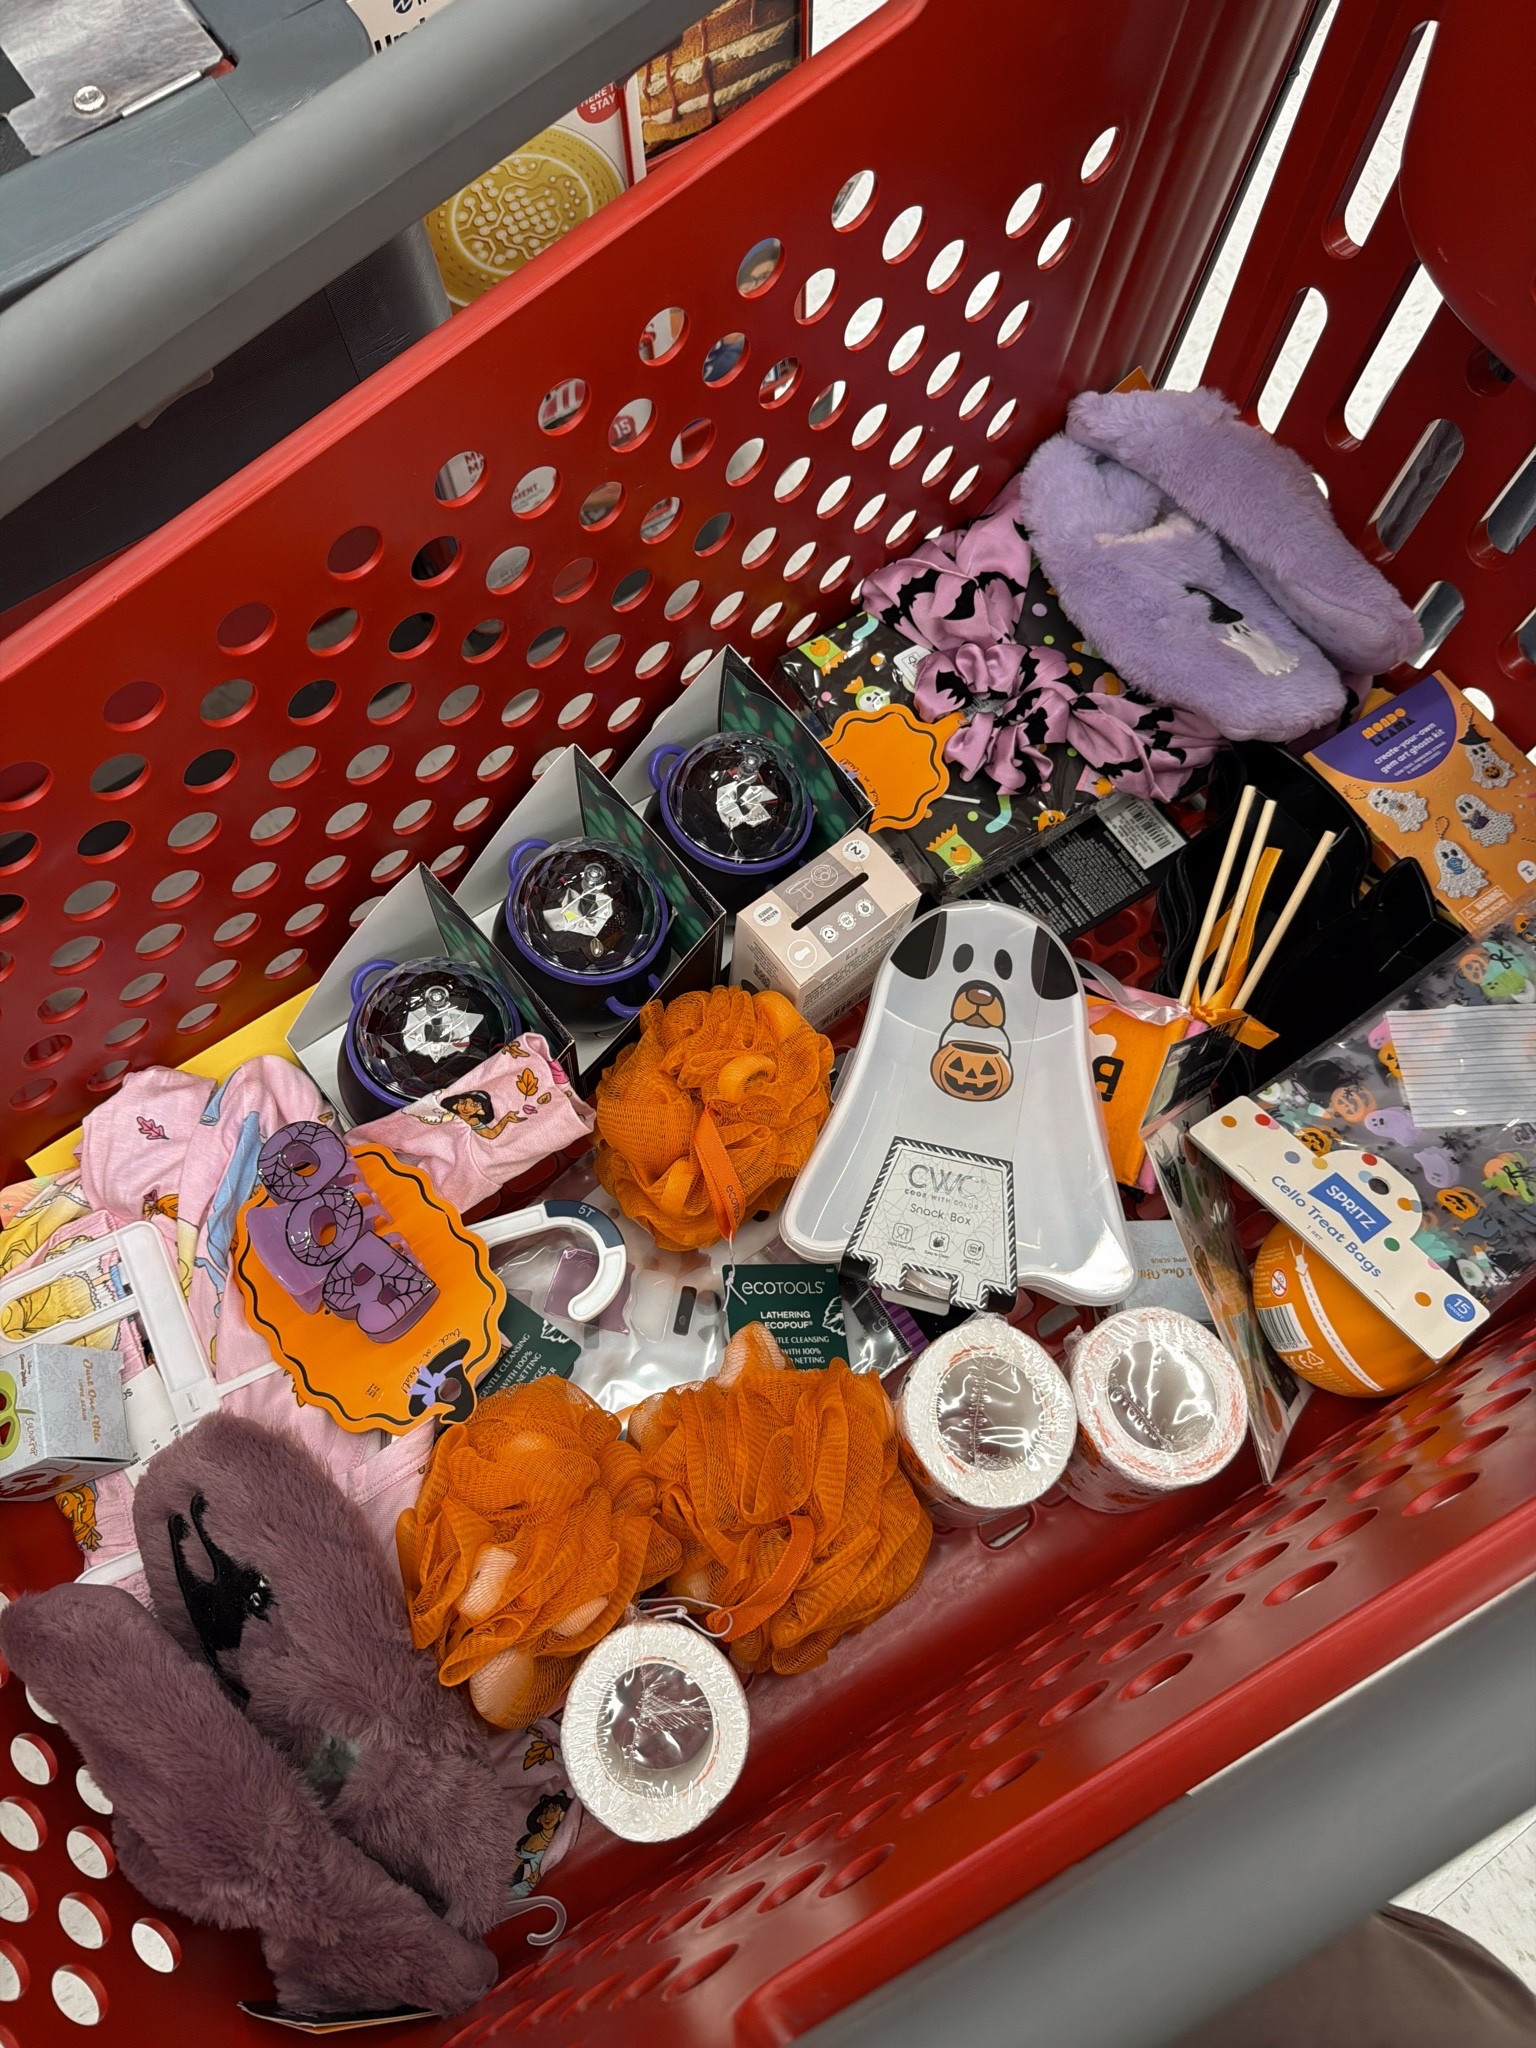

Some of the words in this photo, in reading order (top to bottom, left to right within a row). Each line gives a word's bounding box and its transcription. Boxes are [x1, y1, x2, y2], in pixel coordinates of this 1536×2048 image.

[590, 92, 616, 114] STAY
[613, 418, 631, 440] 15
[1361, 708, 1407, 740] MONDO
[1374, 721, 1436, 765] create-your-own
[1380, 759, 1398, 775] gem
[1398, 752, 1411, 768] art
[1410, 738, 1434, 762] ghosts
[1433, 728, 1445, 744] kit
[851, 845, 862, 856] 2
[757, 905, 774, 919] RUBBER
[761, 909, 779, 924] NATURAL
[904, 1187, 927, 1199] COOK
[931, 1194, 951, 1204] WITH
[954, 1199, 979, 1210] COLOR
[1326, 1185, 1378, 1230] SPRITZ
[577, 1204, 595, 1219] 5T
[909, 1203, 944, 1220] Snack
[950, 1212, 971, 1226] Box
[1271, 1175, 1306, 1207] Cello
[1307, 1205, 1346, 1242] Treat
[1344, 1242, 1382, 1278] Bags
[760, 1310, 811, 1320] LATHERING
[1446, 1303, 1465, 1320] COUNT
[1454, 1298, 1470, 1315] 15
[791, 1335, 830, 1345] CLEANSING
[801, 1347, 821, 1356] 100%
[478, 1374, 502, 1399] GENTLE
[499, 1332, 531, 1375] CLEANSING
[515, 1349, 533, 1372] 100%
[517, 1352, 543, 1381] NETTING
[794, 1356, 826, 1365] NETTING
[82, 1358, 95, 1389] Just
[88, 1389, 97, 1412] One
[25, 1417, 39, 1457] COLOURPOP
[92, 1414, 101, 1446] Bite
